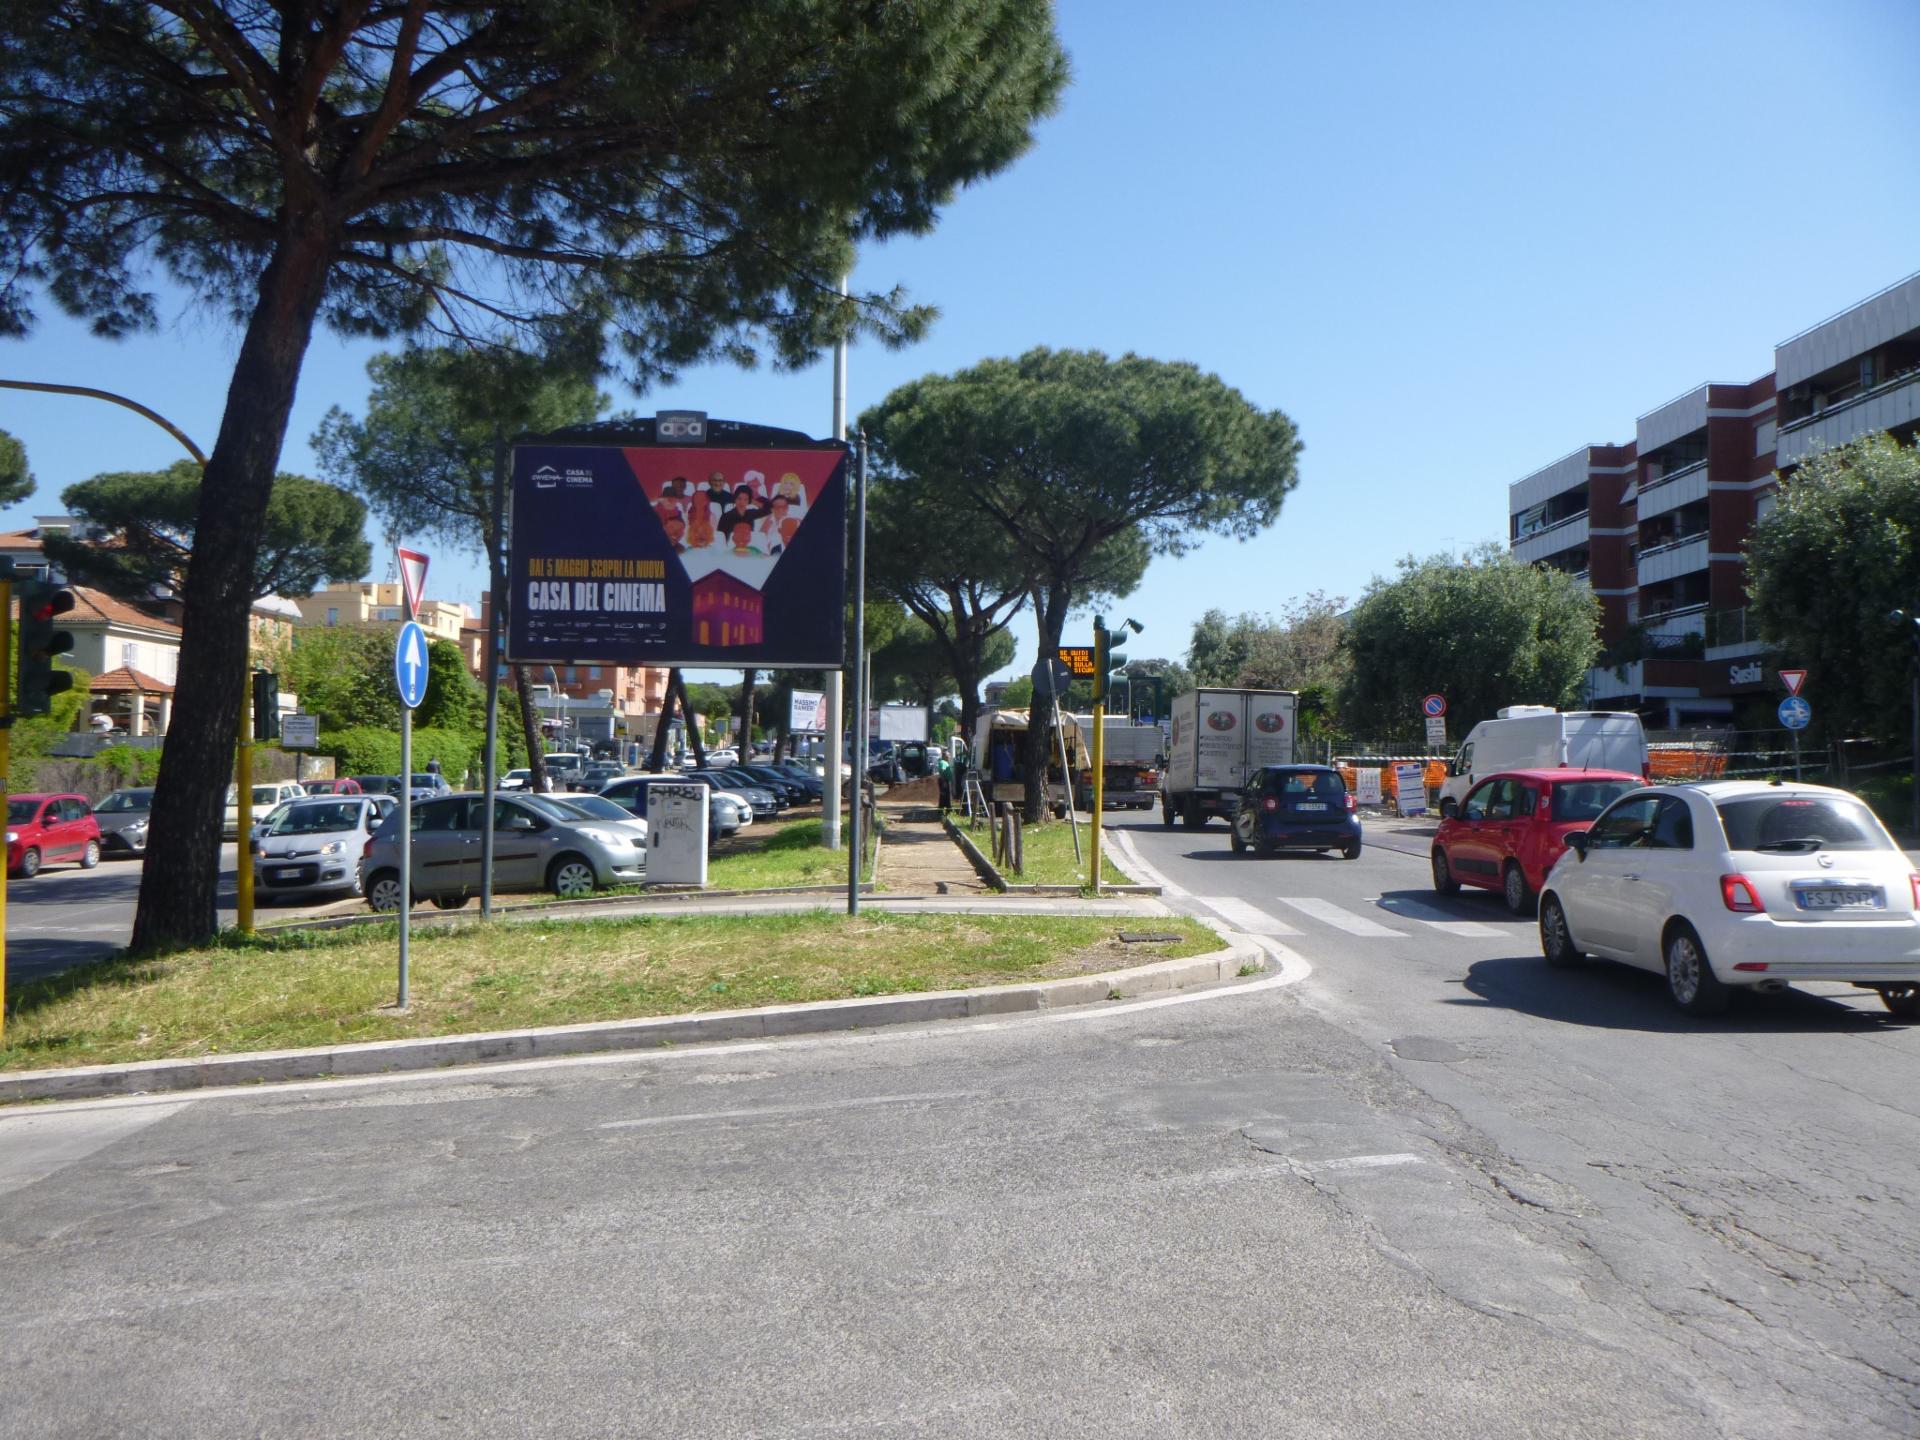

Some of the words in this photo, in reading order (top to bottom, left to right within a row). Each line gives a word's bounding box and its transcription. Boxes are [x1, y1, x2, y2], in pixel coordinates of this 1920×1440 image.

[660, 422, 702, 438] apa
[529, 559, 544, 577] DAL
[546, 559, 553, 577] 5
[555, 559, 589, 577] MAGGIO
[591, 560, 622, 578] SCOPRI
[625, 560, 634, 578] LA
[636, 560, 665, 579] NUOVA
[528, 581, 571, 611] CASA
[574, 582, 600, 611] DEL
[603, 582, 666, 612] CINEMA
[1730, 661, 1763, 685] Sushi
